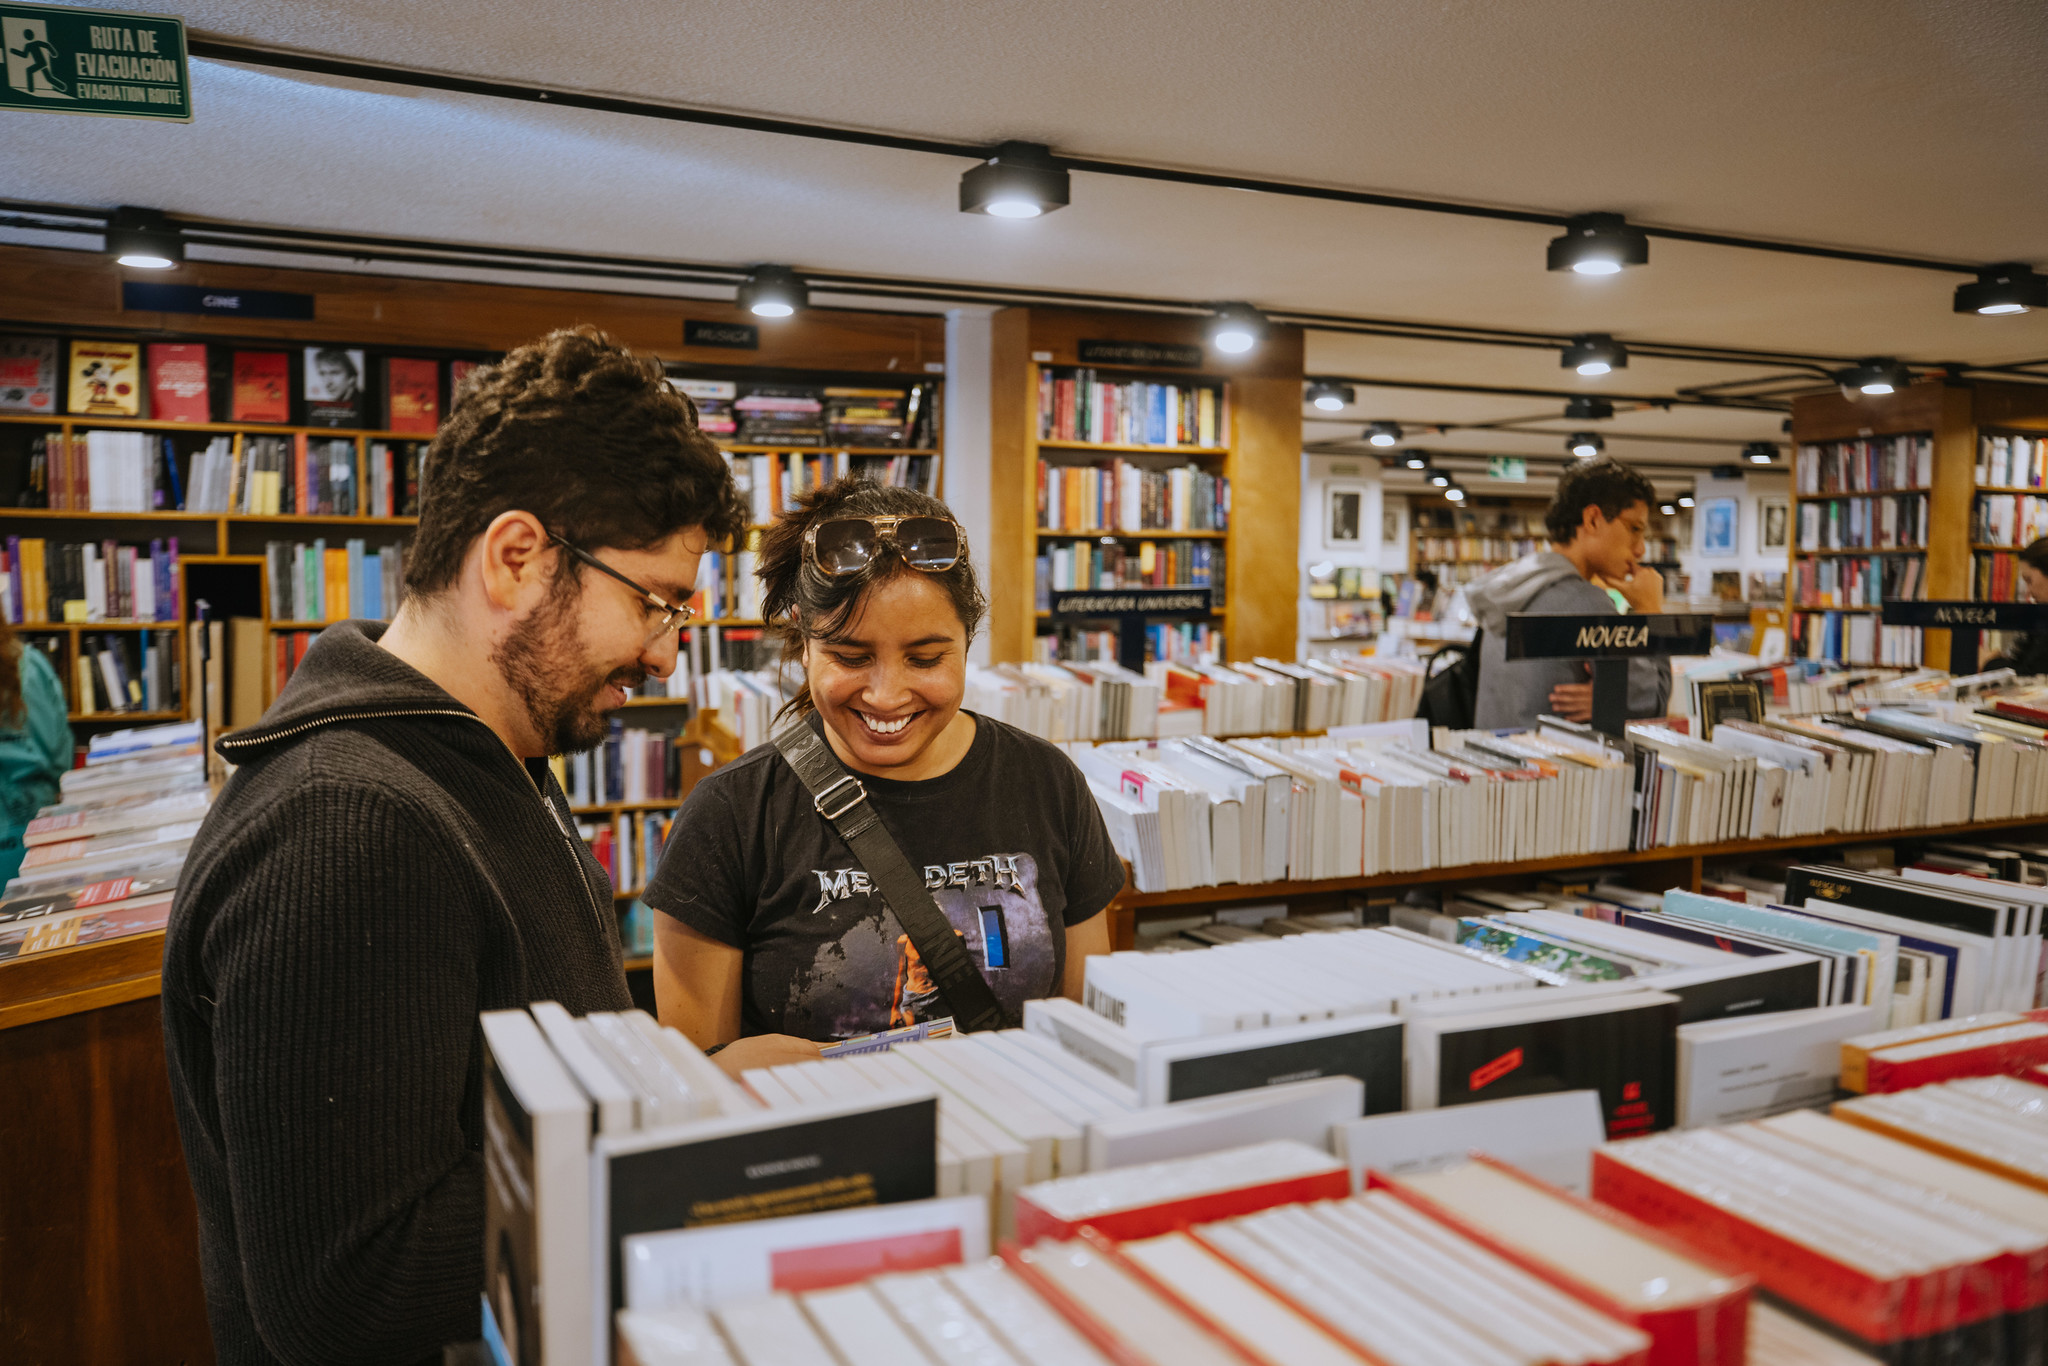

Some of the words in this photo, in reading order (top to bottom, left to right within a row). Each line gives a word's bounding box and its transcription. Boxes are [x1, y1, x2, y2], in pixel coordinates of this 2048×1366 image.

[90, 25, 135, 52] RUTA
[137, 29, 159, 54] DE
[75, 52, 178, 83] EVACUACIÓN
[77, 82, 146, 102] EVACUATION
[147, 87, 183, 105] ROUTE
[202, 294, 240, 308] CINE
[1057, 596, 1136, 613] LITERATURA
[1137, 594, 1205, 611] UNIVERSAL
[1934, 606, 1997, 624] NOVELA
[1576, 625, 1649, 648] NOVELA
